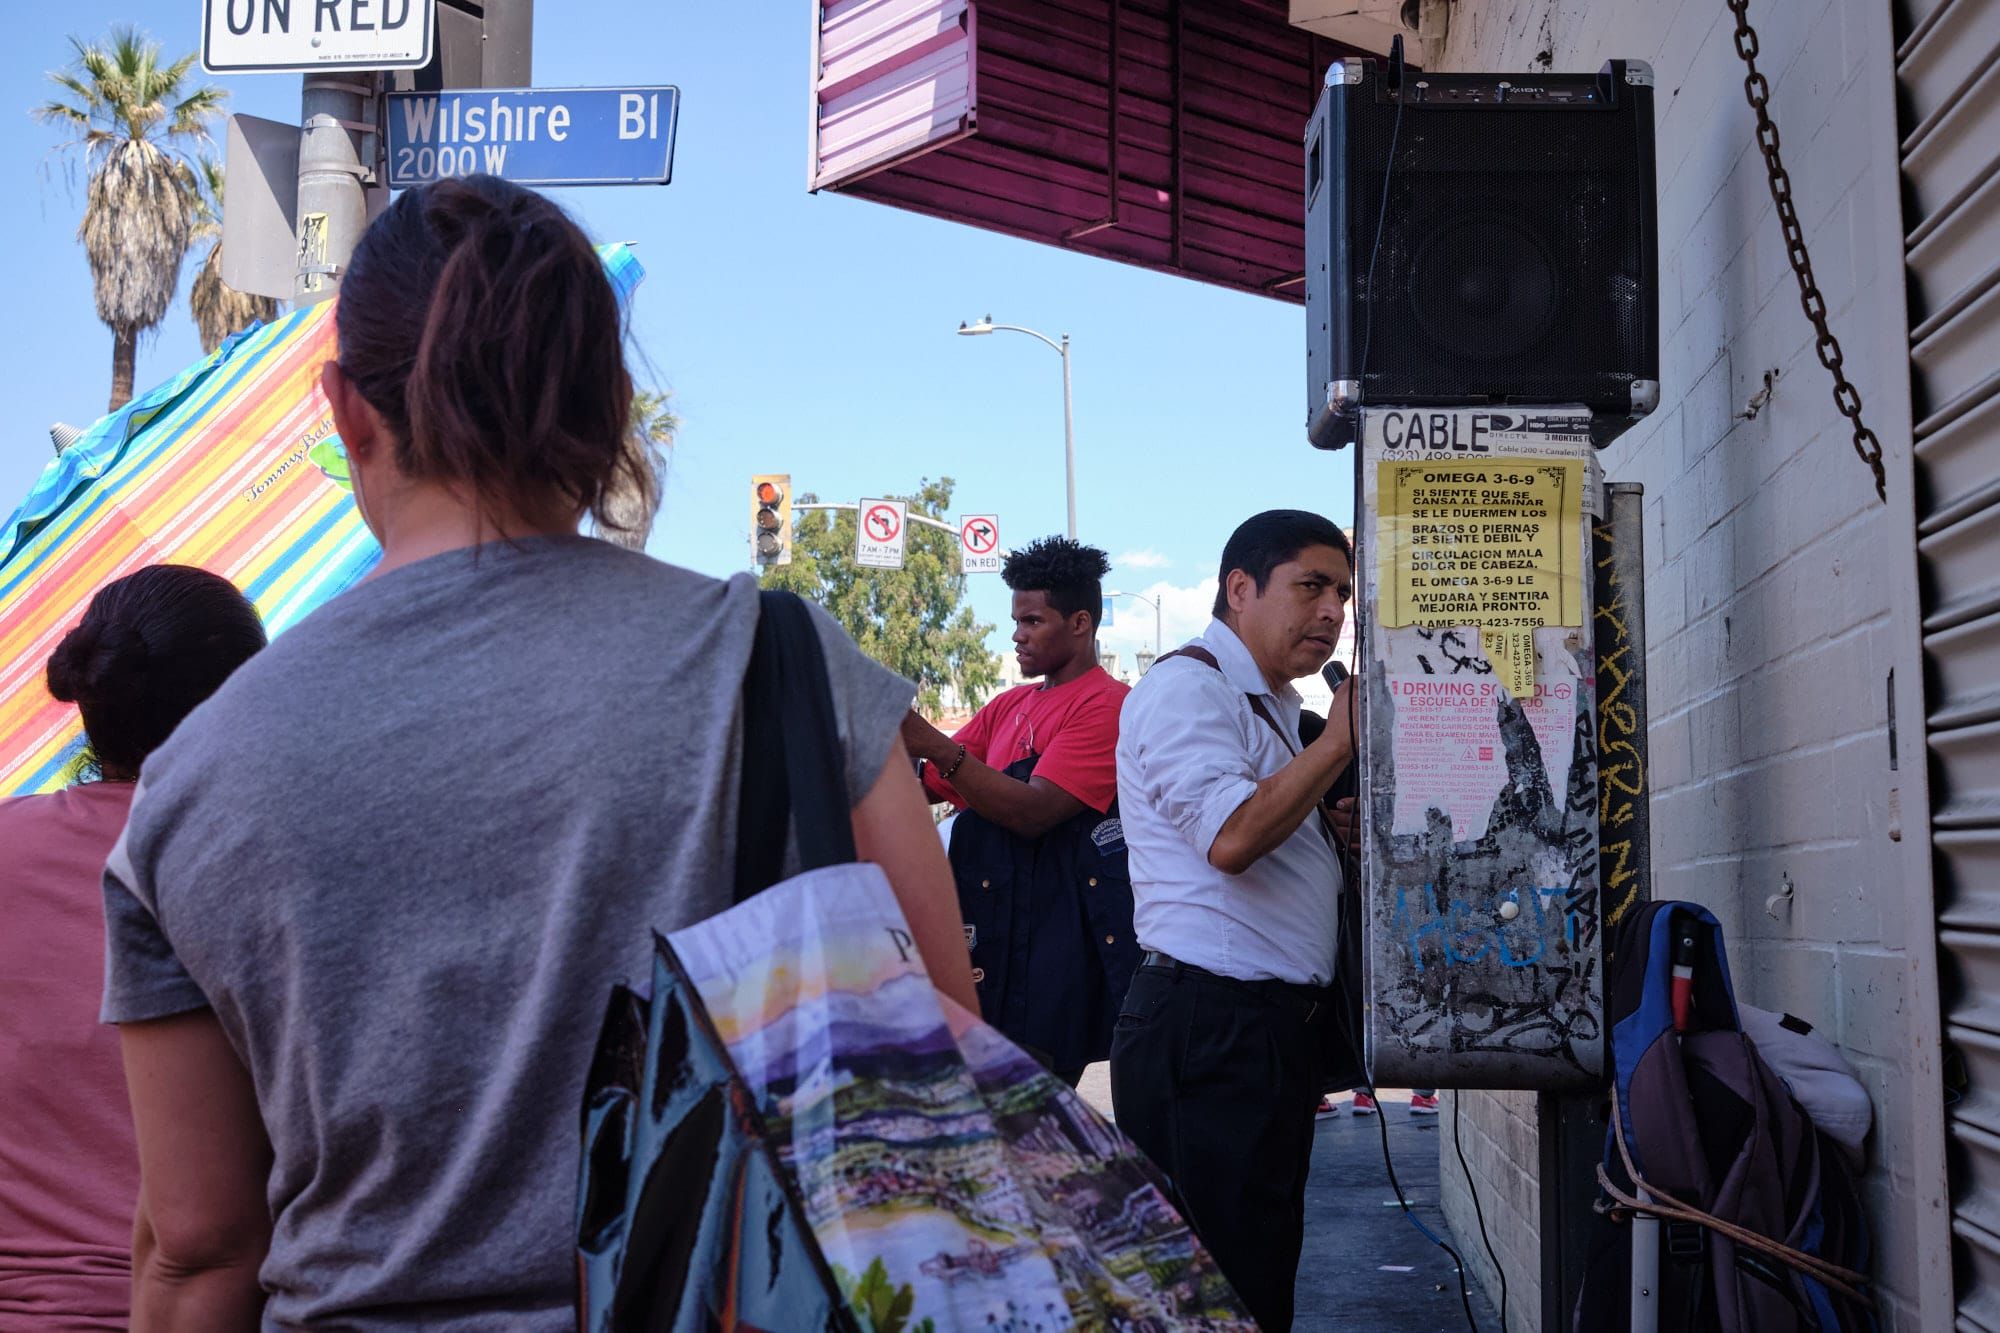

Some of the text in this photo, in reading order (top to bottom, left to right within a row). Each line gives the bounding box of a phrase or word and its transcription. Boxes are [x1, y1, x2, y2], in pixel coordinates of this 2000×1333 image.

[226, 0, 409, 35] ON RED
[403, 93, 658, 144] Wilshire Bl
[397, 145, 507, 179] 2000 W
[1382, 412, 1490, 451] CABLE
[1551, 433, 1583, 443] MONTHS
[1381, 449, 1419, 461] (323)
[1498, 445, 1519, 453] Cable
[1520, 446, 1538, 455] (200
[1545, 448, 1578, 458] Canales)
[243, 419, 333, 502] Tommy Bah
[1424, 473, 1535, 485] OMEGA 3-6-9
[1413, 489, 1530, 499] SI SIENTE QUE SE
[1413, 497, 1457, 505] CANSA
[1482, 498, 1544, 506] CAMINAR
[1412, 509, 1547, 518] SE LE DUERMEN LOS
[1412, 524, 1540, 534] BRAZOS O PIERNAS
[1412, 533, 1535, 544] SE SIENTE DEBIL Y
[883, 546, 888, 554] 7
[1412, 549, 1543, 560] CIRCULACION MALA
[965, 558, 997, 568] ON RED
[1412, 560, 1538, 571] DOLOR DE CABEZA.
[1411, 575, 1534, 587] EL OMEGA 3-6-9 LE
[1411, 591, 1550, 603] AYUDARA Y SENTIRA
[1419, 602, 1541, 613] MEJORIA PRONTO.
[1460, 617, 1544, 627] 323-423-7556
[1512, 632, 1522, 692] 323-423-7556
[1523, 634, 1533, 686] OMEGA-369
[1403, 682, 1475, 696] DRIVING
[1410, 697, 1468, 707] ESCUELA
[1471, 697, 1486, 707] DE
[1093, 819, 1122, 839] AMERICA
